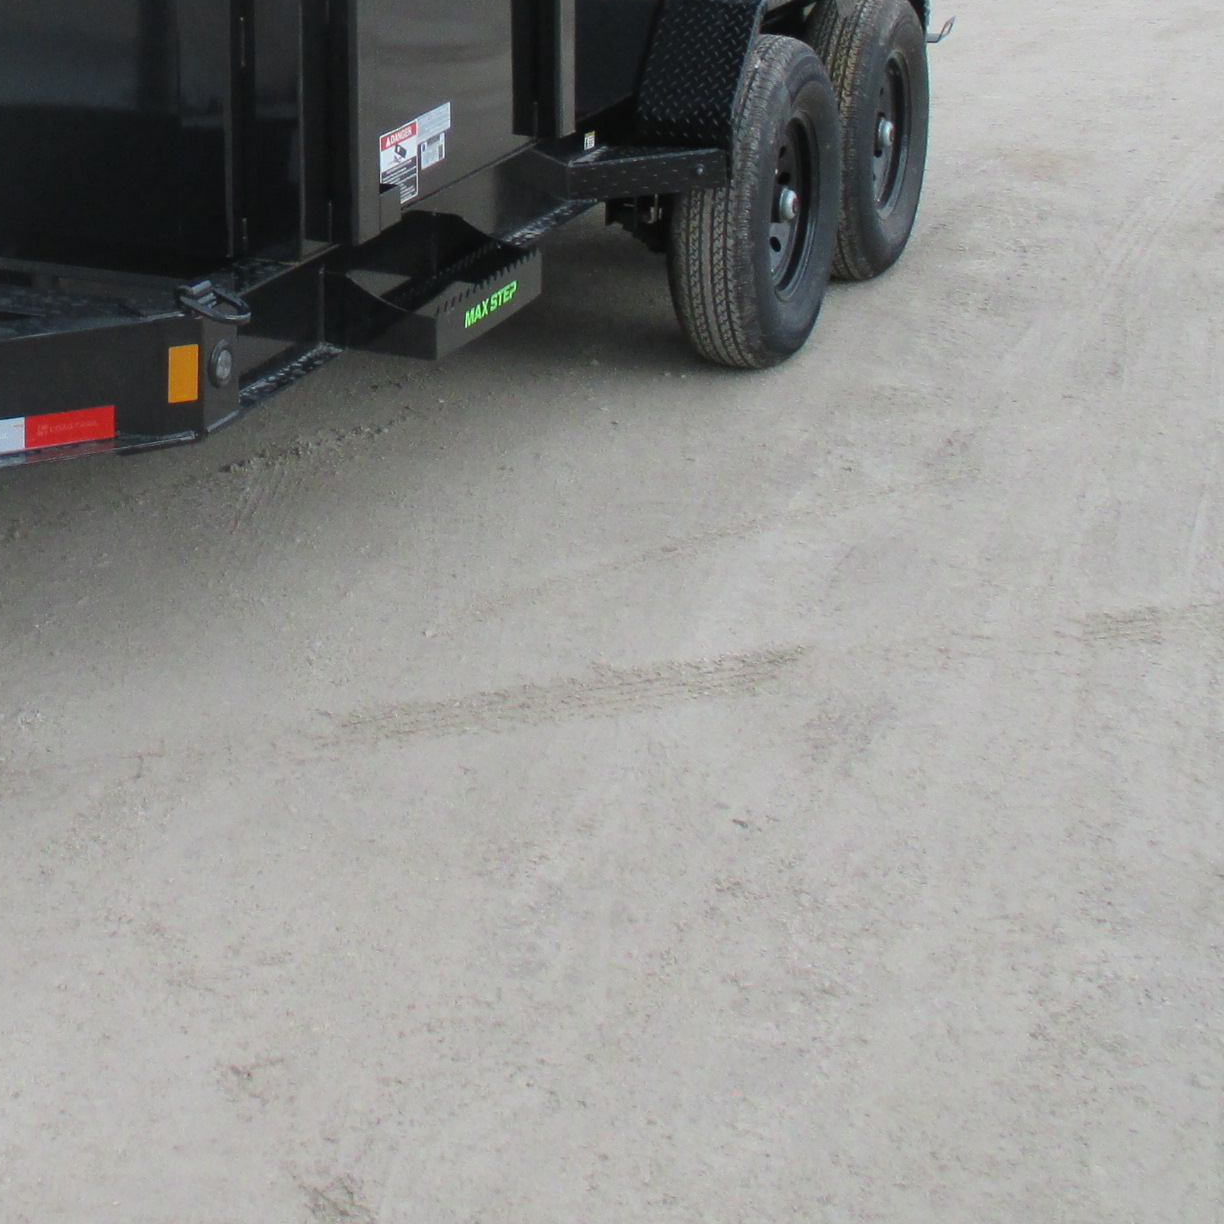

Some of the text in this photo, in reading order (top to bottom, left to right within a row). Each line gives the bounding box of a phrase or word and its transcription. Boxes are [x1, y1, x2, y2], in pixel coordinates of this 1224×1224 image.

[390, 126, 412, 144] DANGER
[465, 280, 517, 328] MAX STEP
